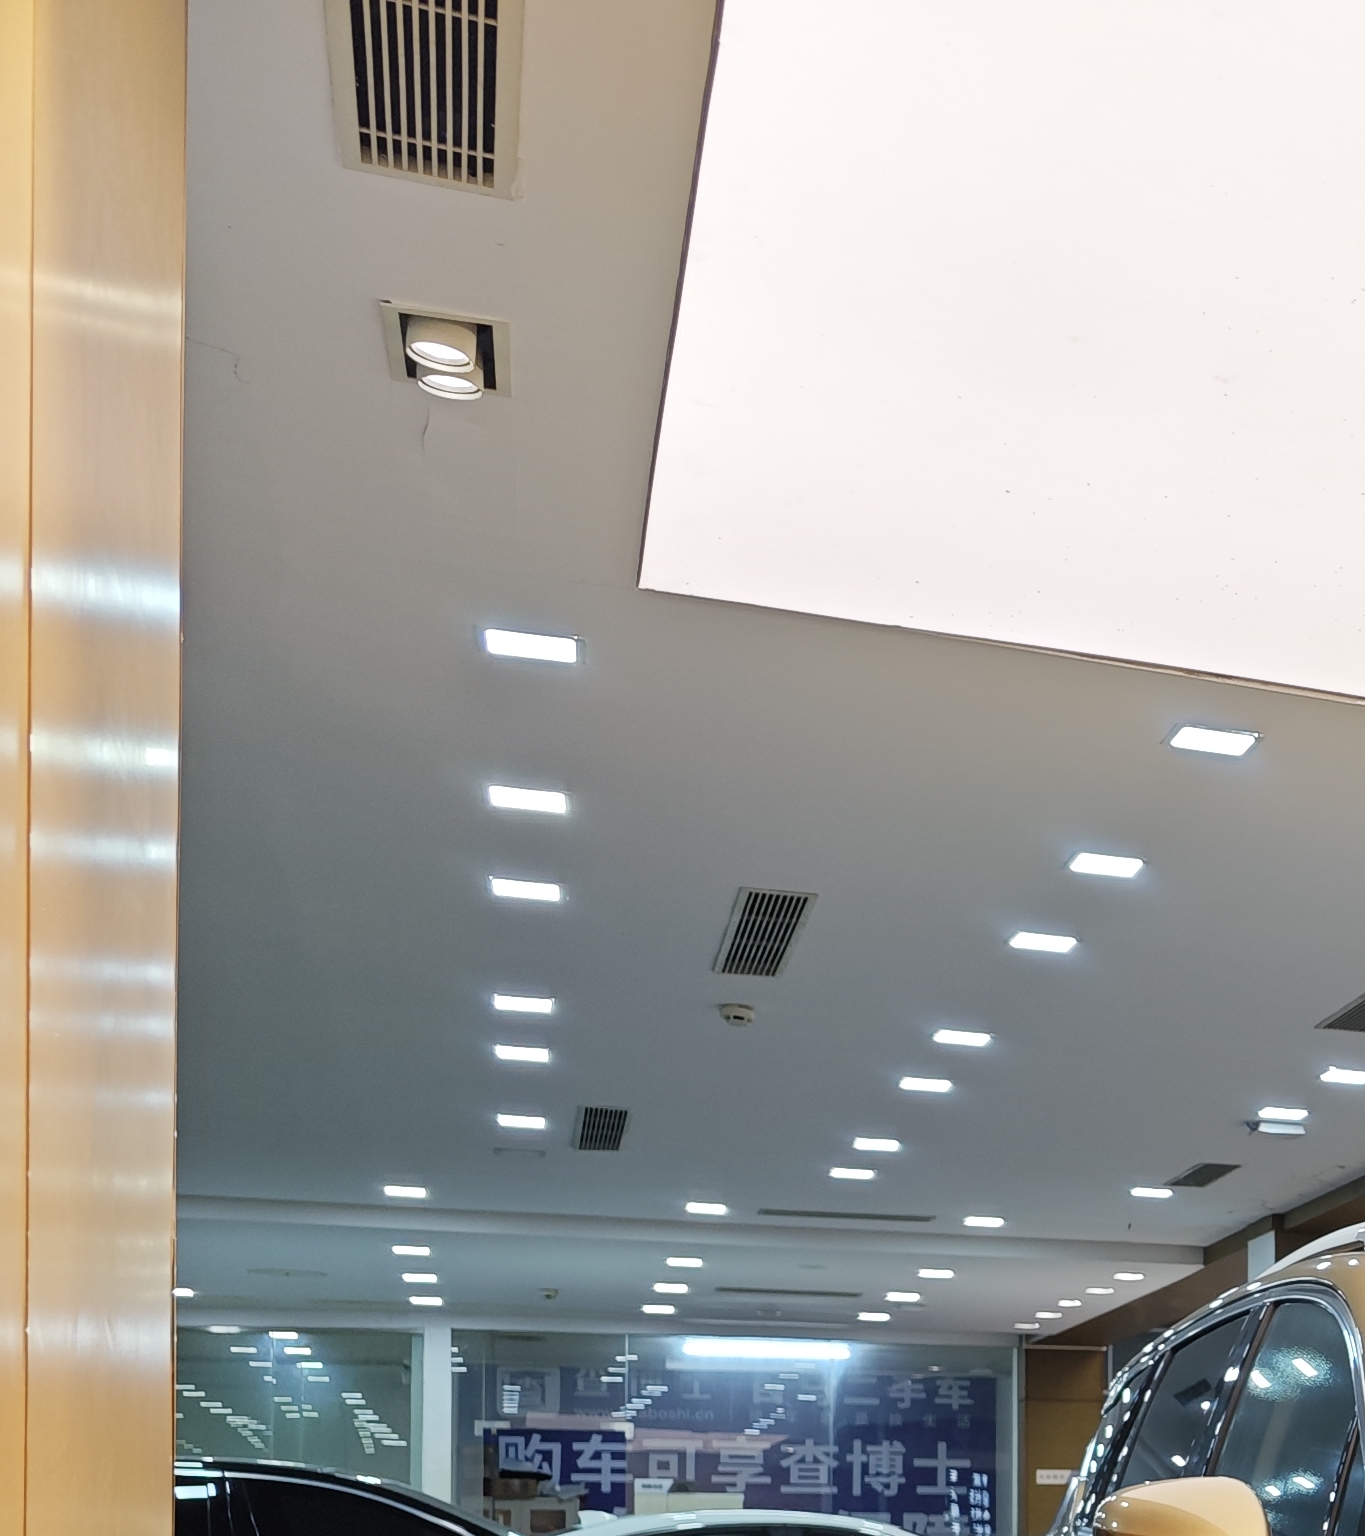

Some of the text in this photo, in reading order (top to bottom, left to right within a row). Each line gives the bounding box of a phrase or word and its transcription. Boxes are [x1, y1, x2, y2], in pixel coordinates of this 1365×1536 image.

[498, 1433, 972, 1497] 购车可享查博士
